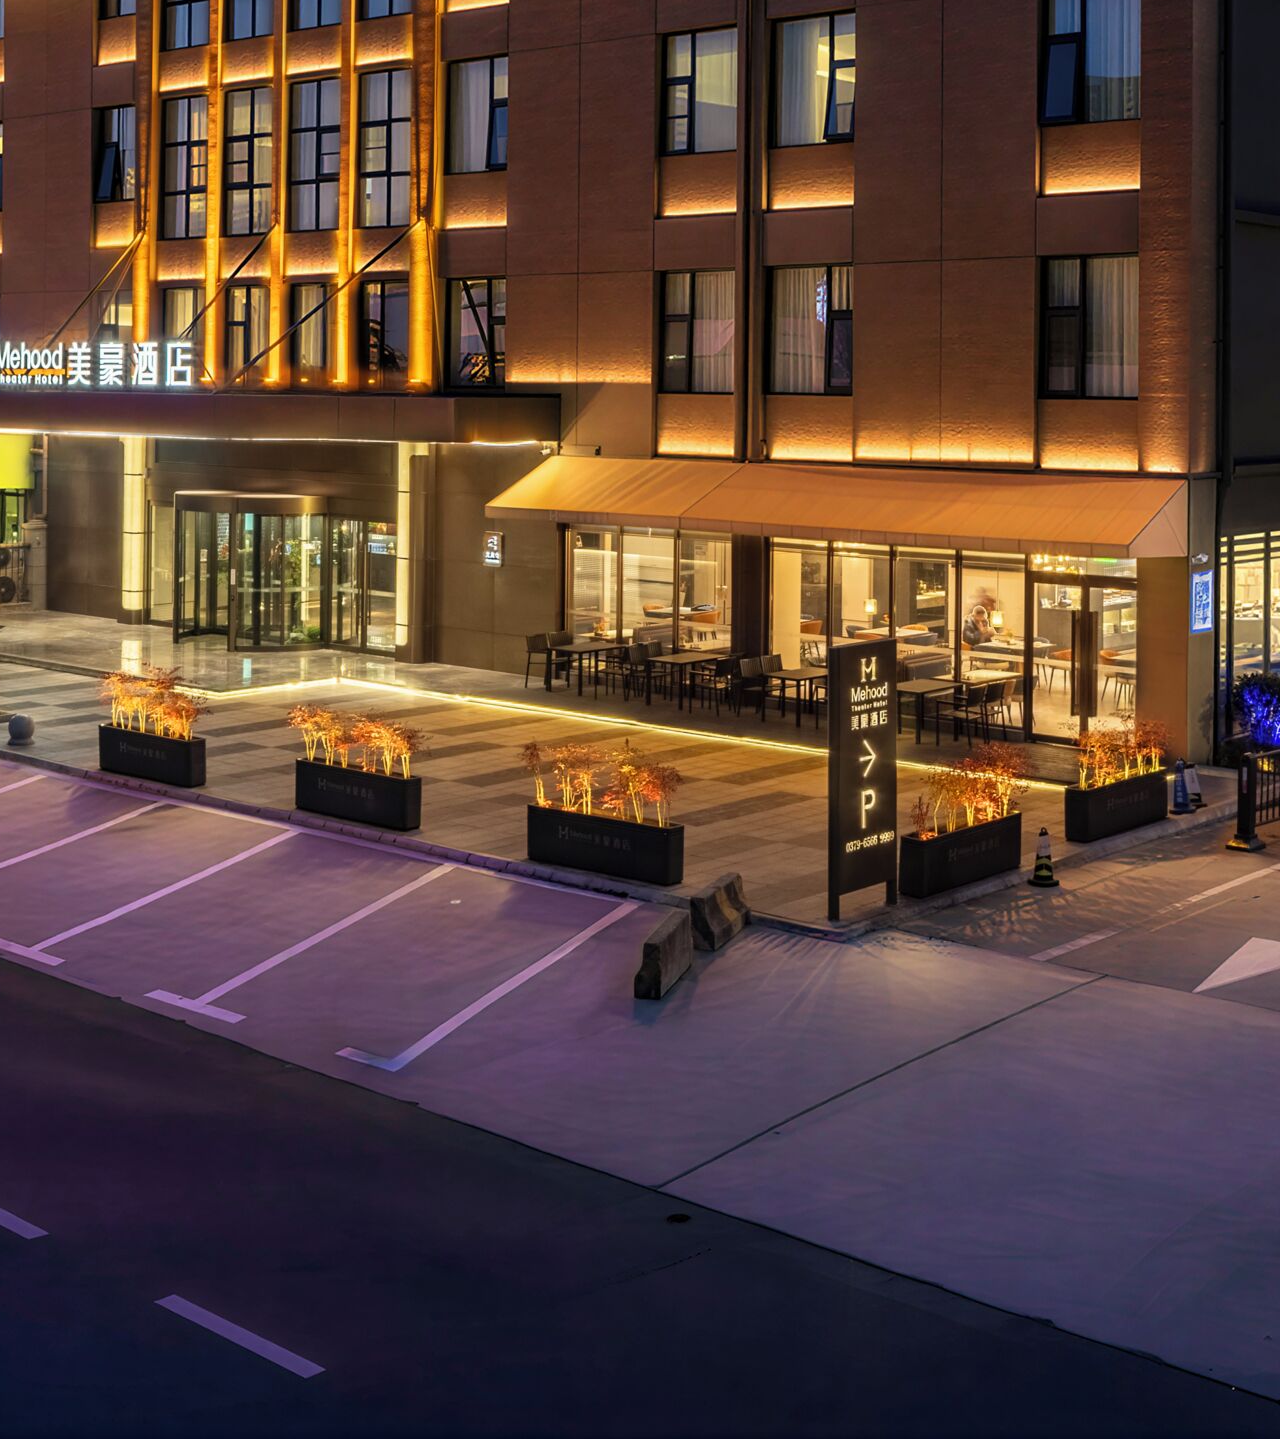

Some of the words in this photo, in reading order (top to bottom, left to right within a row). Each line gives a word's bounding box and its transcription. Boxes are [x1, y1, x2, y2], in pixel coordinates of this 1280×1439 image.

[67, 341, 193, 387] 美豪酒店
[34, 373, 63, 385] Hotel
[850, 681, 889, 703] Mehood
[850, 709, 888, 731] 美豪酒店
[860, 788, 876, 829] P
